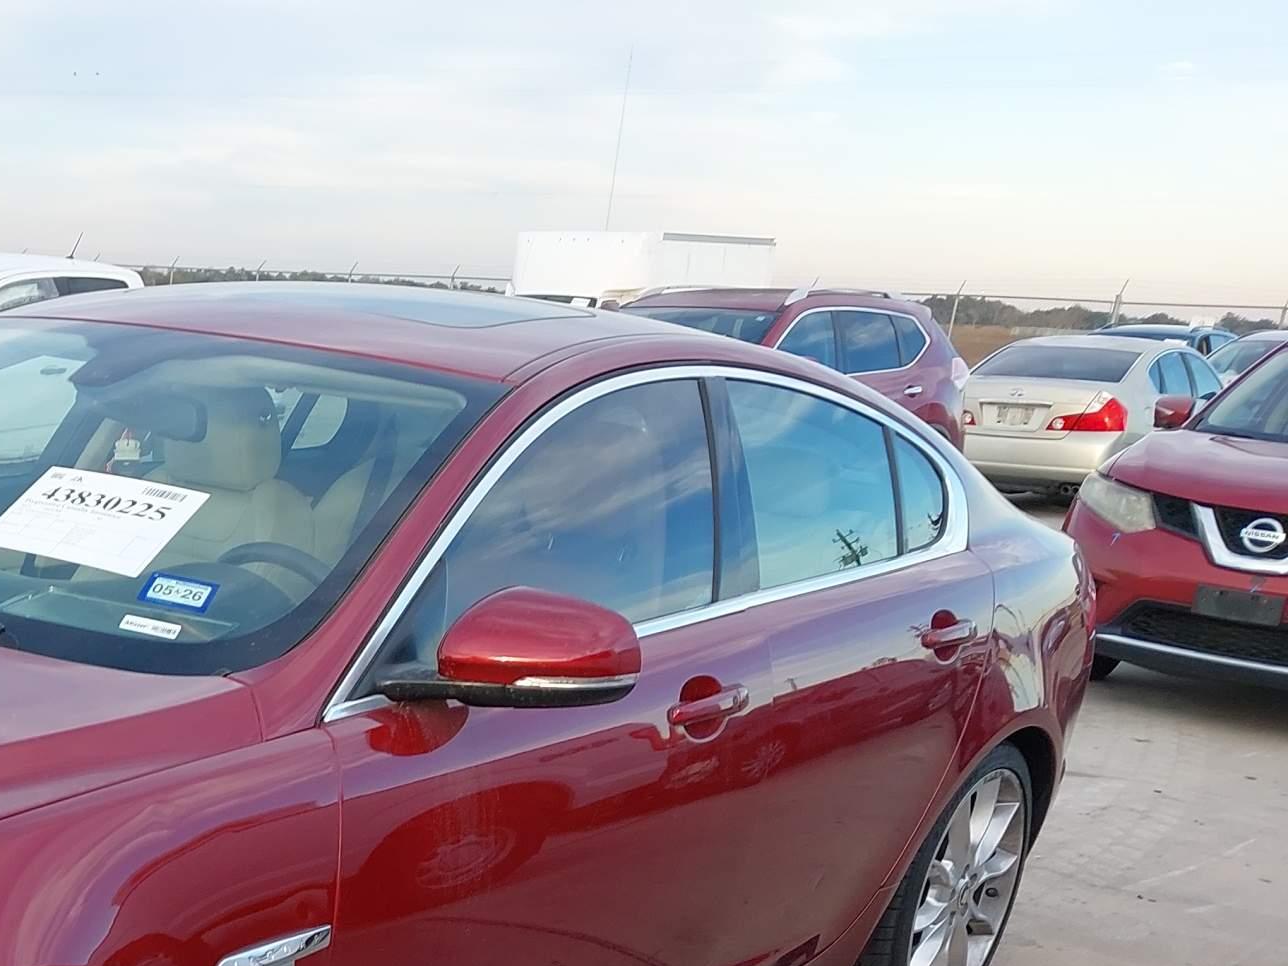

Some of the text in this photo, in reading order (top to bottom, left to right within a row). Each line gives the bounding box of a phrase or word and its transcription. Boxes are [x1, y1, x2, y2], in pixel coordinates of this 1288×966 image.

[42, 486, 172, 521] 43830225
[1244, 530, 1280, 540] NISSAN
[152, 583, 174, 597] 05
[180, 588, 204, 602] 26
